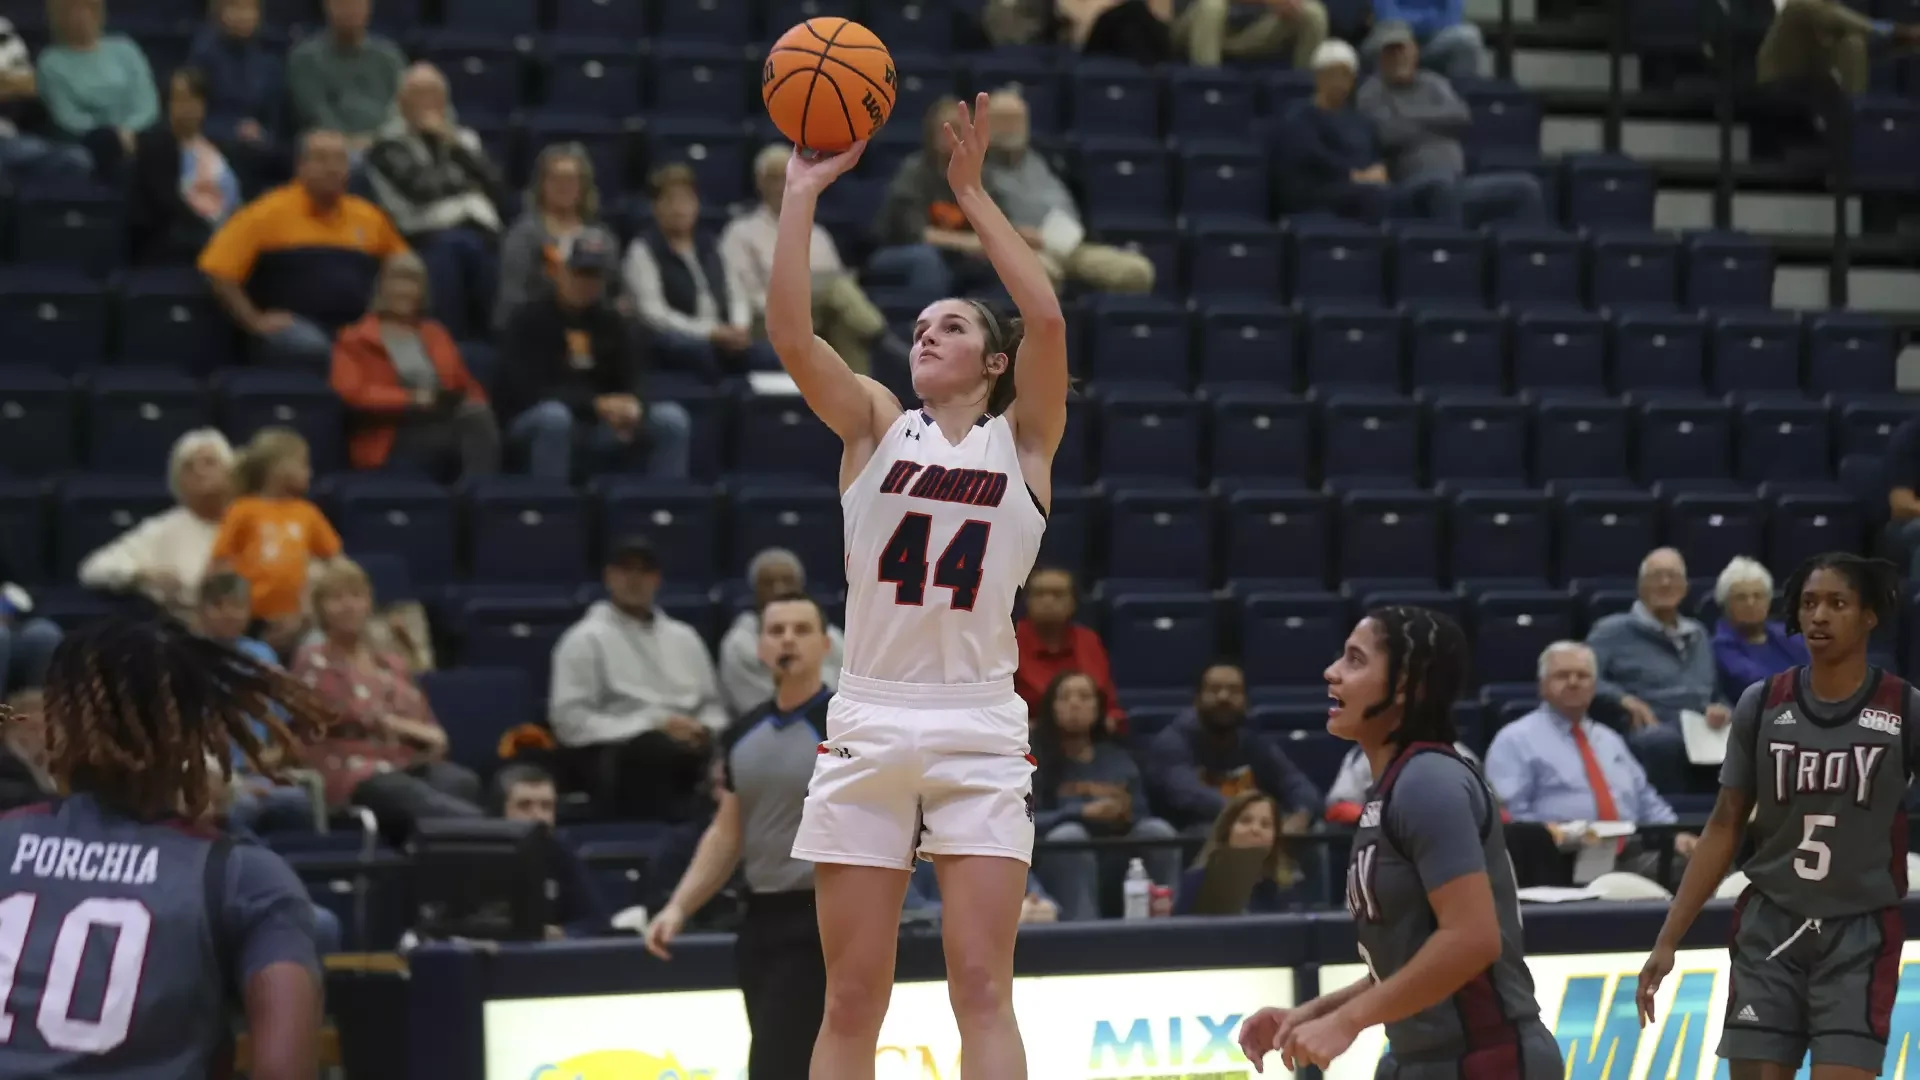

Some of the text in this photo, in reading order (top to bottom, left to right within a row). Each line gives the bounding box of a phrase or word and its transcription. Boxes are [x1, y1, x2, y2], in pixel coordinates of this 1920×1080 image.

[880, 459, 1008, 508] UT MARTIN
[878, 511, 991, 612] 44
[1768, 741, 1887, 809] TROY
[10, 833, 160, 885] PORCHIA
[1793, 813, 1837, 882] 5
[0, 892, 152, 1056] 10
[1088, 1013, 1247, 1069] MIX
